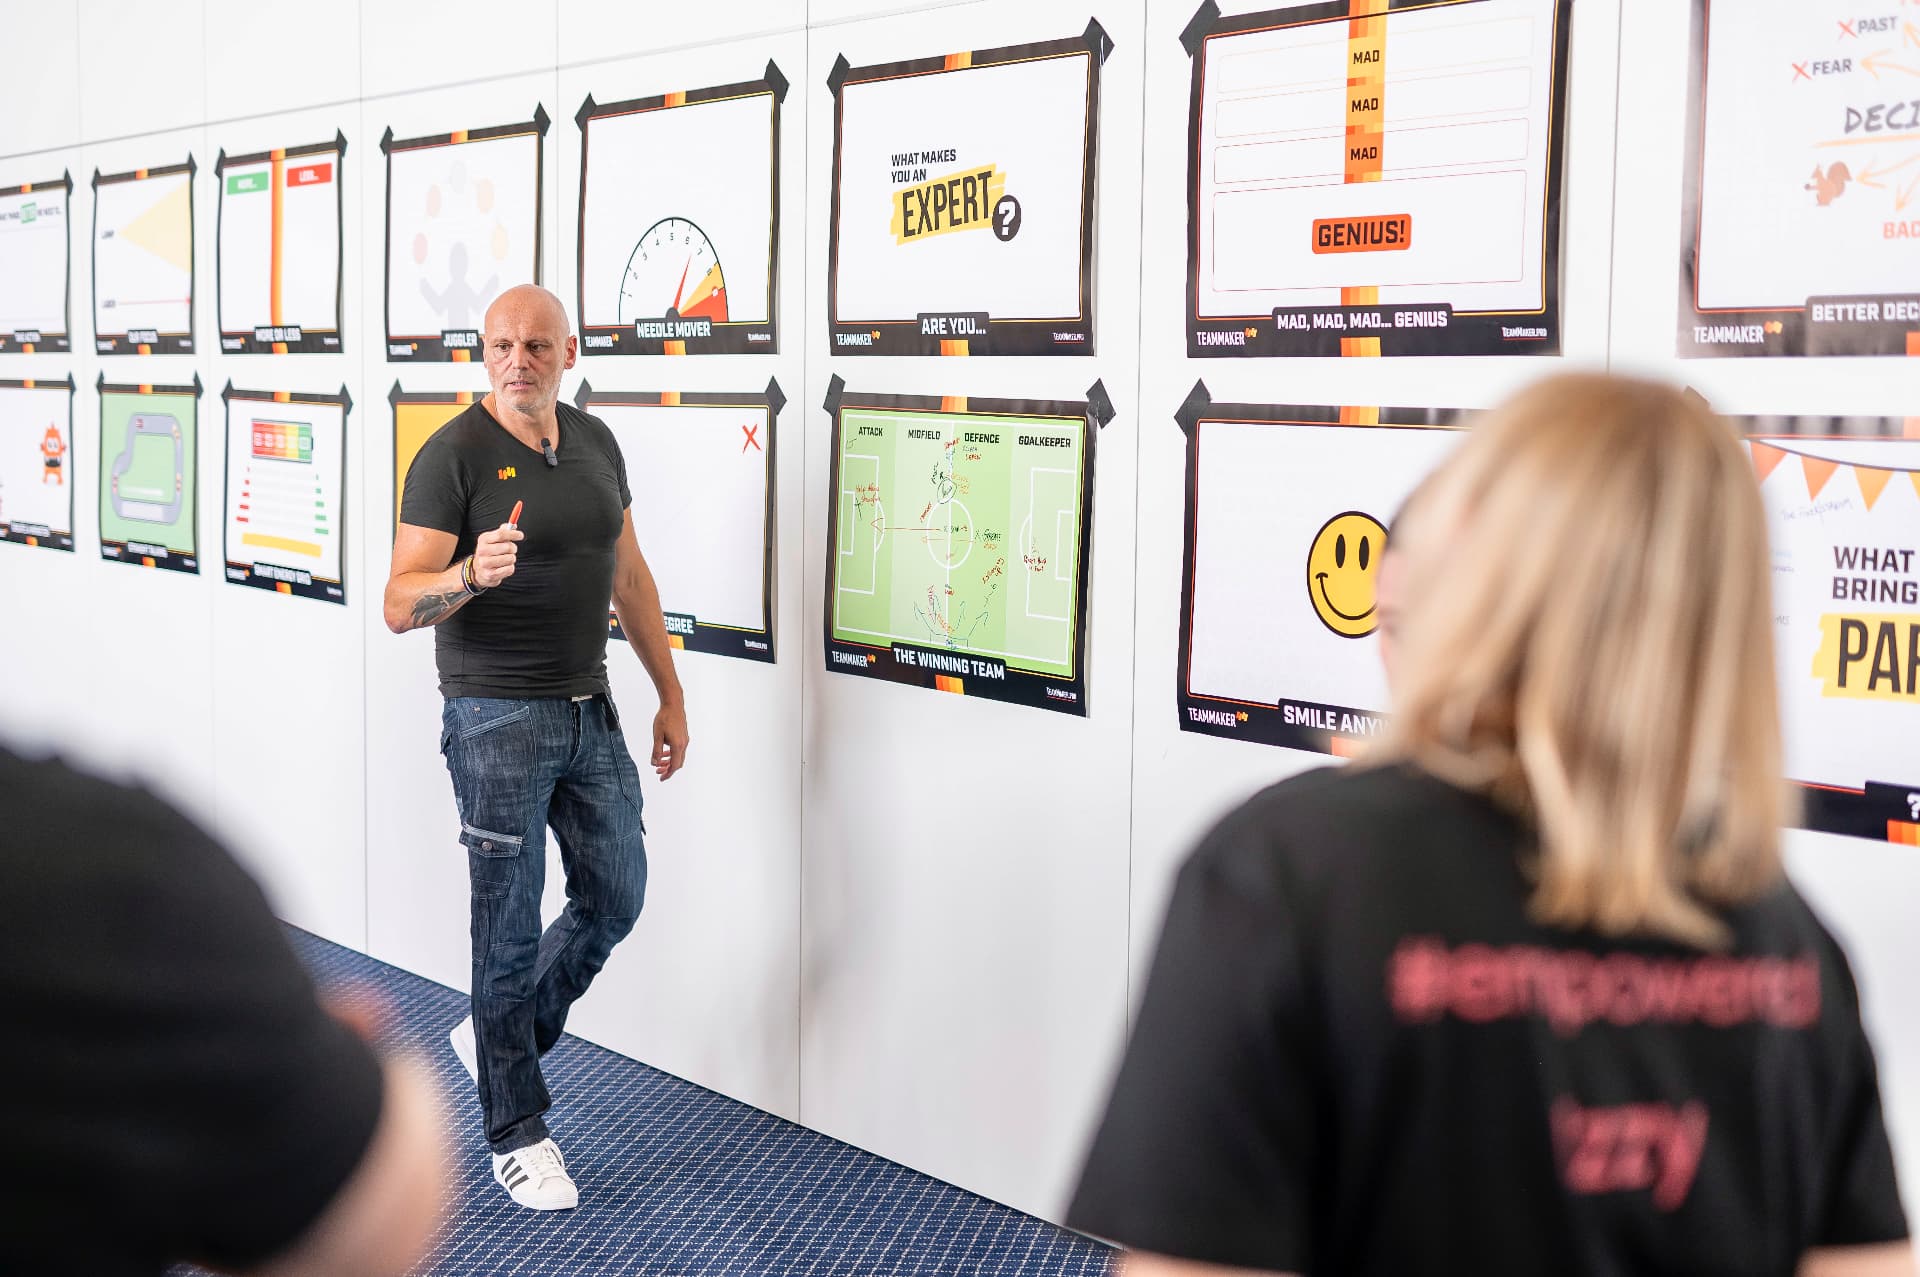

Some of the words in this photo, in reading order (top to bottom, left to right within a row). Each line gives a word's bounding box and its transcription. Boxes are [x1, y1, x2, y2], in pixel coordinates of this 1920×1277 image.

[1858, 16, 1898, 34] PAST
[1353, 50, 1380, 64] MAD
[1812, 58, 1852, 75] FEAR
[1351, 98, 1379, 112] MAD
[891, 152, 919, 167] WHAT
[921, 149, 957, 164] MAKES
[1350, 146, 1377, 161] MAD
[891, 170, 910, 183] YOU
[912, 168, 927, 181] AN
[902, 170, 992, 238] EXPERT
[1318, 219, 1405, 247] GENIUS!
[1812, 303, 1880, 321] BETTER
[636, 322, 673, 338] NEEDLE
[675, 321, 711, 338] MOVER
[921, 318, 948, 335] ARE
[948, 318, 986, 335] YOU...
[1277, 314, 1310, 331] MAD,
[1313, 314, 1347, 331] MAD,
[1349, 313, 1392, 329] MAD...
[1394, 311, 1448, 328] GENIUS
[443, 332, 478, 347] JUGGLER
[836, 333, 872, 345] TEAMMAKER
[1197, 331, 1246, 345] TEAMMAKER
[1694, 325, 1765, 343] TEAMMAKER
[858, 426, 883, 437] ATTACK
[907, 429, 941, 440] MIDFIELD
[964, 432, 1000, 444] DEFENCE
[1018, 435, 1071, 448] GOALKEEPER
[1833, 545, 1915, 573] WHAT
[1832, 576, 1918, 605] BRING
[832, 650, 868, 668] TEAMMAKER
[893, 648, 916, 665] THE
[917, 652, 970, 674] WINNING
[970, 660, 1005, 680] TEAM
[1187, 707, 1237, 727] TEAMMAKER
[1283, 705, 1337, 731] SMILE
